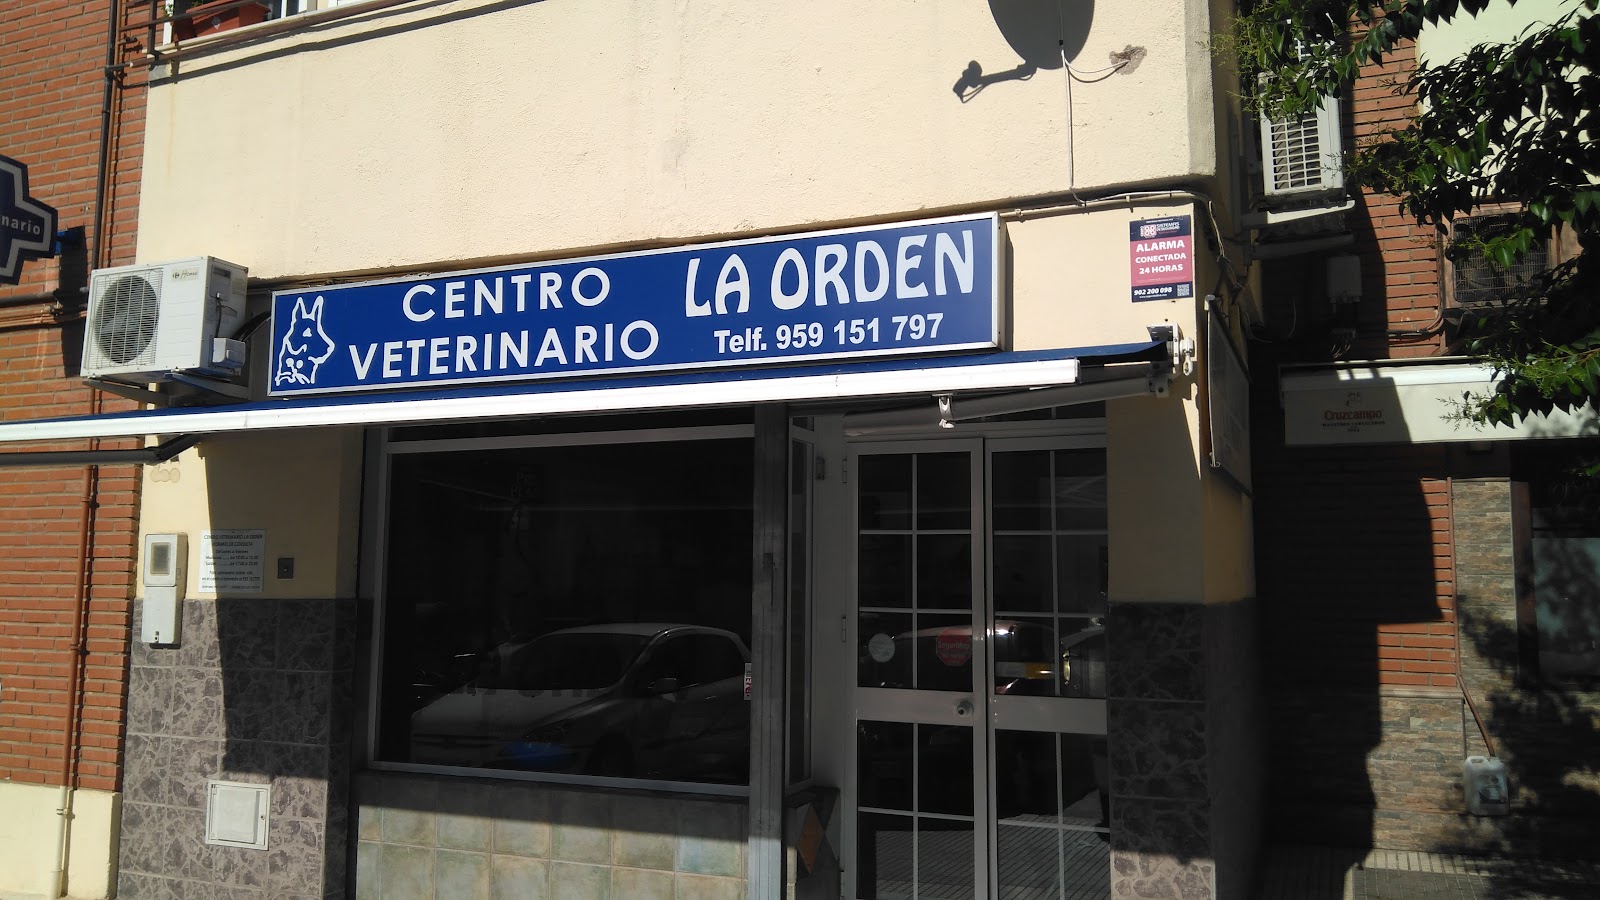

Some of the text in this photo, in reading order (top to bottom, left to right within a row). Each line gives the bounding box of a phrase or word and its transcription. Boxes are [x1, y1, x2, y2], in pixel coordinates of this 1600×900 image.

[1136, 240, 1185, 252] ALARMA
[1135, 253, 1187, 264] CONECTADA
[686, 230, 973, 317] LA ORDEN
[1139, 264, 1184, 275] 24 HORAS
[403, 268, 610, 321] CENTRO
[1147, 287, 1159, 295] 200
[1160, 286, 1173, 294] 098
[714, 313, 943, 353] Telf. 959 151 797
[349, 320, 659, 379] VETERINARIO
[1323, 410, 1383, 421] Cruzcampo
